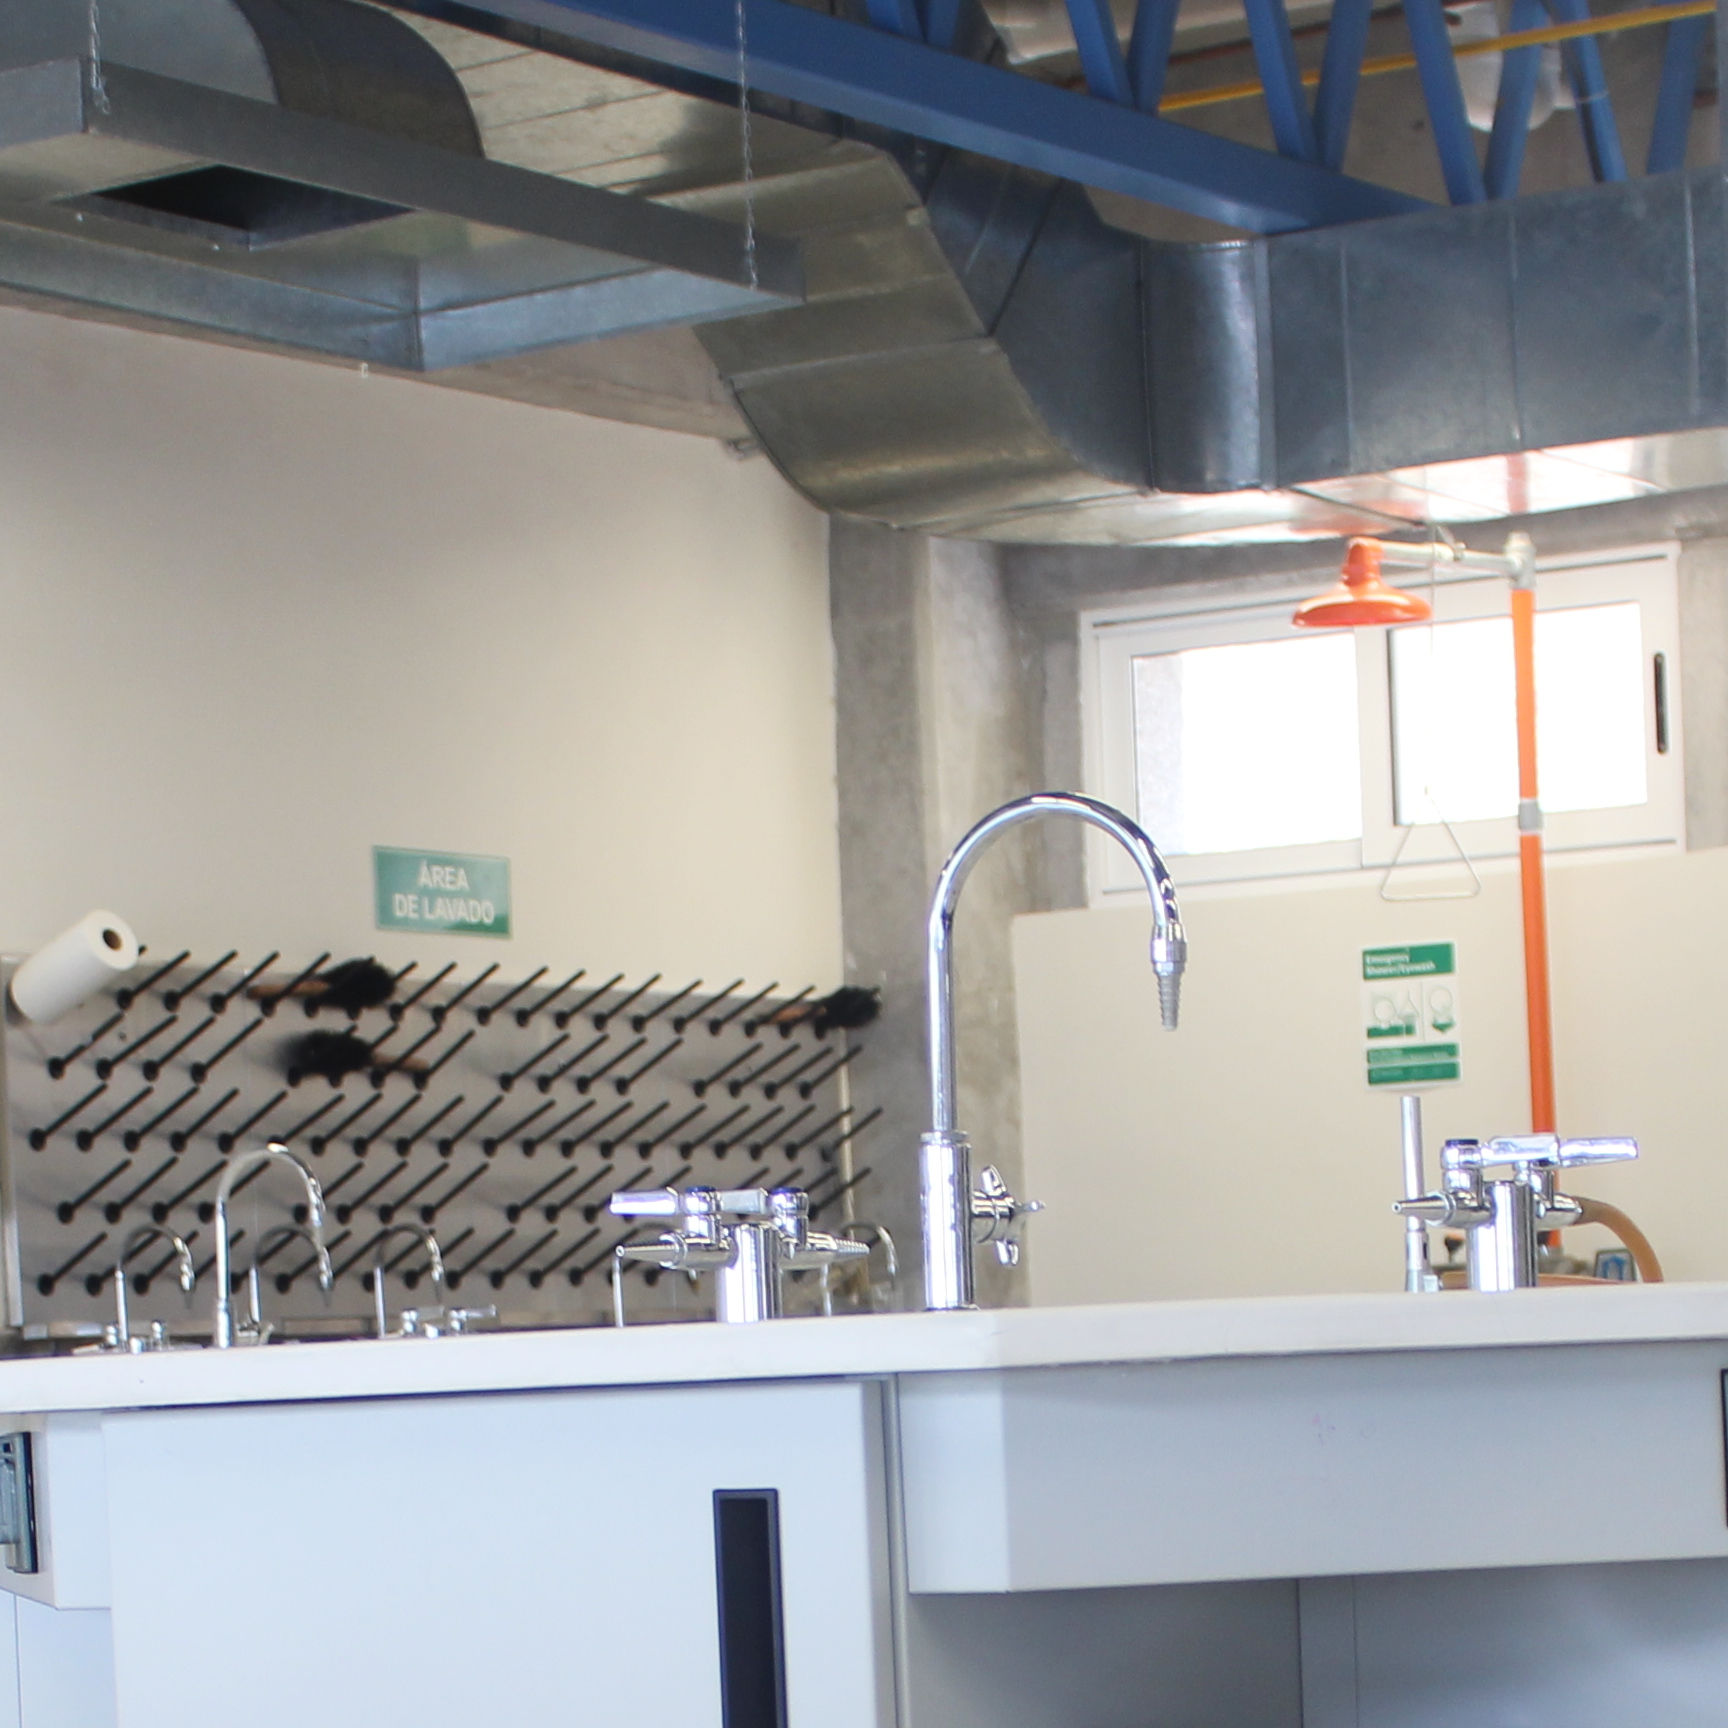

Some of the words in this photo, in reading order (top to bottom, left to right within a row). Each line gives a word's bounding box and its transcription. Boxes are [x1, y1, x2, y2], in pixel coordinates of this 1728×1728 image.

[418, 859, 469, 890] ÁREA
[393, 893, 419, 918] DE
[423, 897, 495, 925] LAVADO
